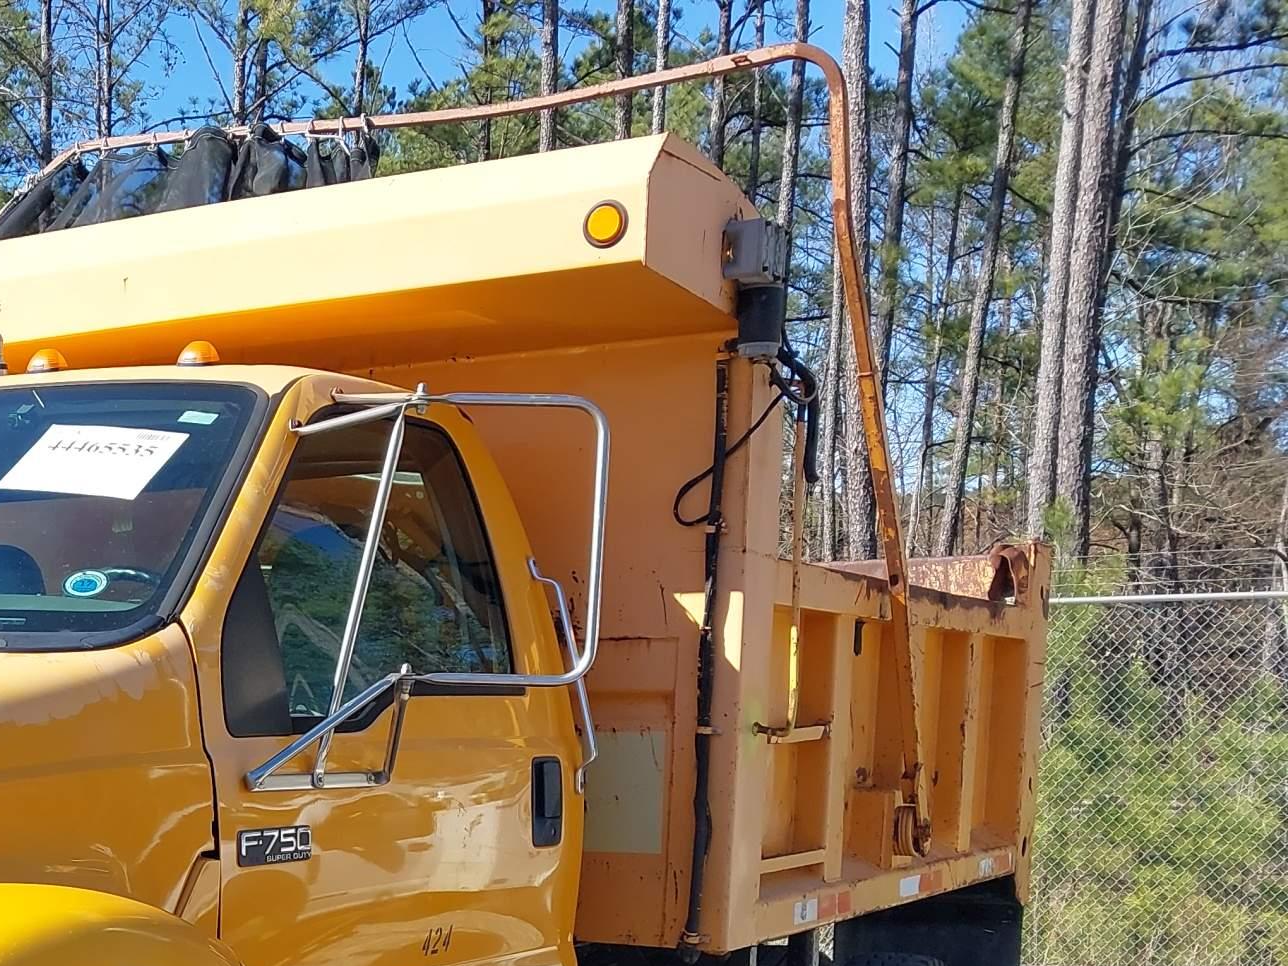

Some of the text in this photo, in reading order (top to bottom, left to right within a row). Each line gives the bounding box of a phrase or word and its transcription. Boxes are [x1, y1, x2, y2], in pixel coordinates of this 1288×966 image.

[48, 439, 158, 457] 44465535
[266, 851, 312, 863] SUPER DUTY
[421, 923, 454, 957] 424
